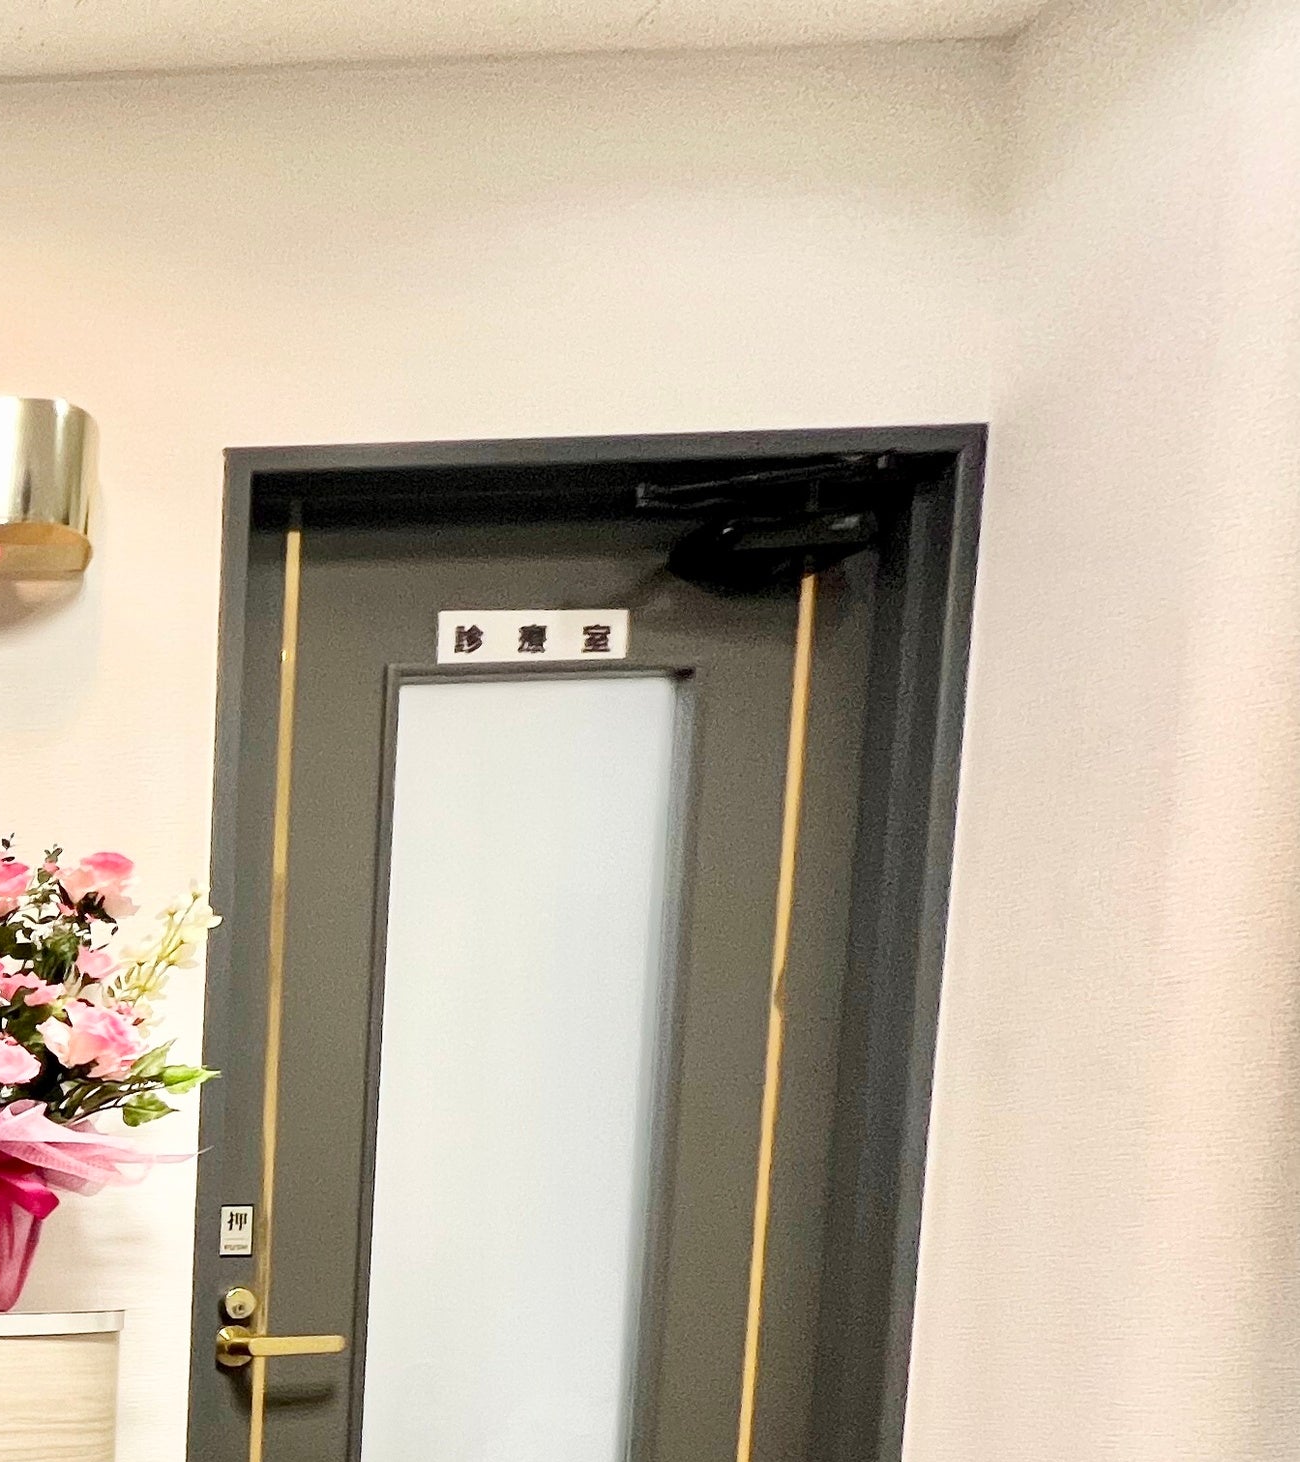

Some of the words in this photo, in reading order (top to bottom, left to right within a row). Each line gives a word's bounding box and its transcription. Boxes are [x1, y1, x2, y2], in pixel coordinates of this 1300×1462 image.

[454, 624, 611, 653] 診療室
[227, 1211, 248, 1231] 押
